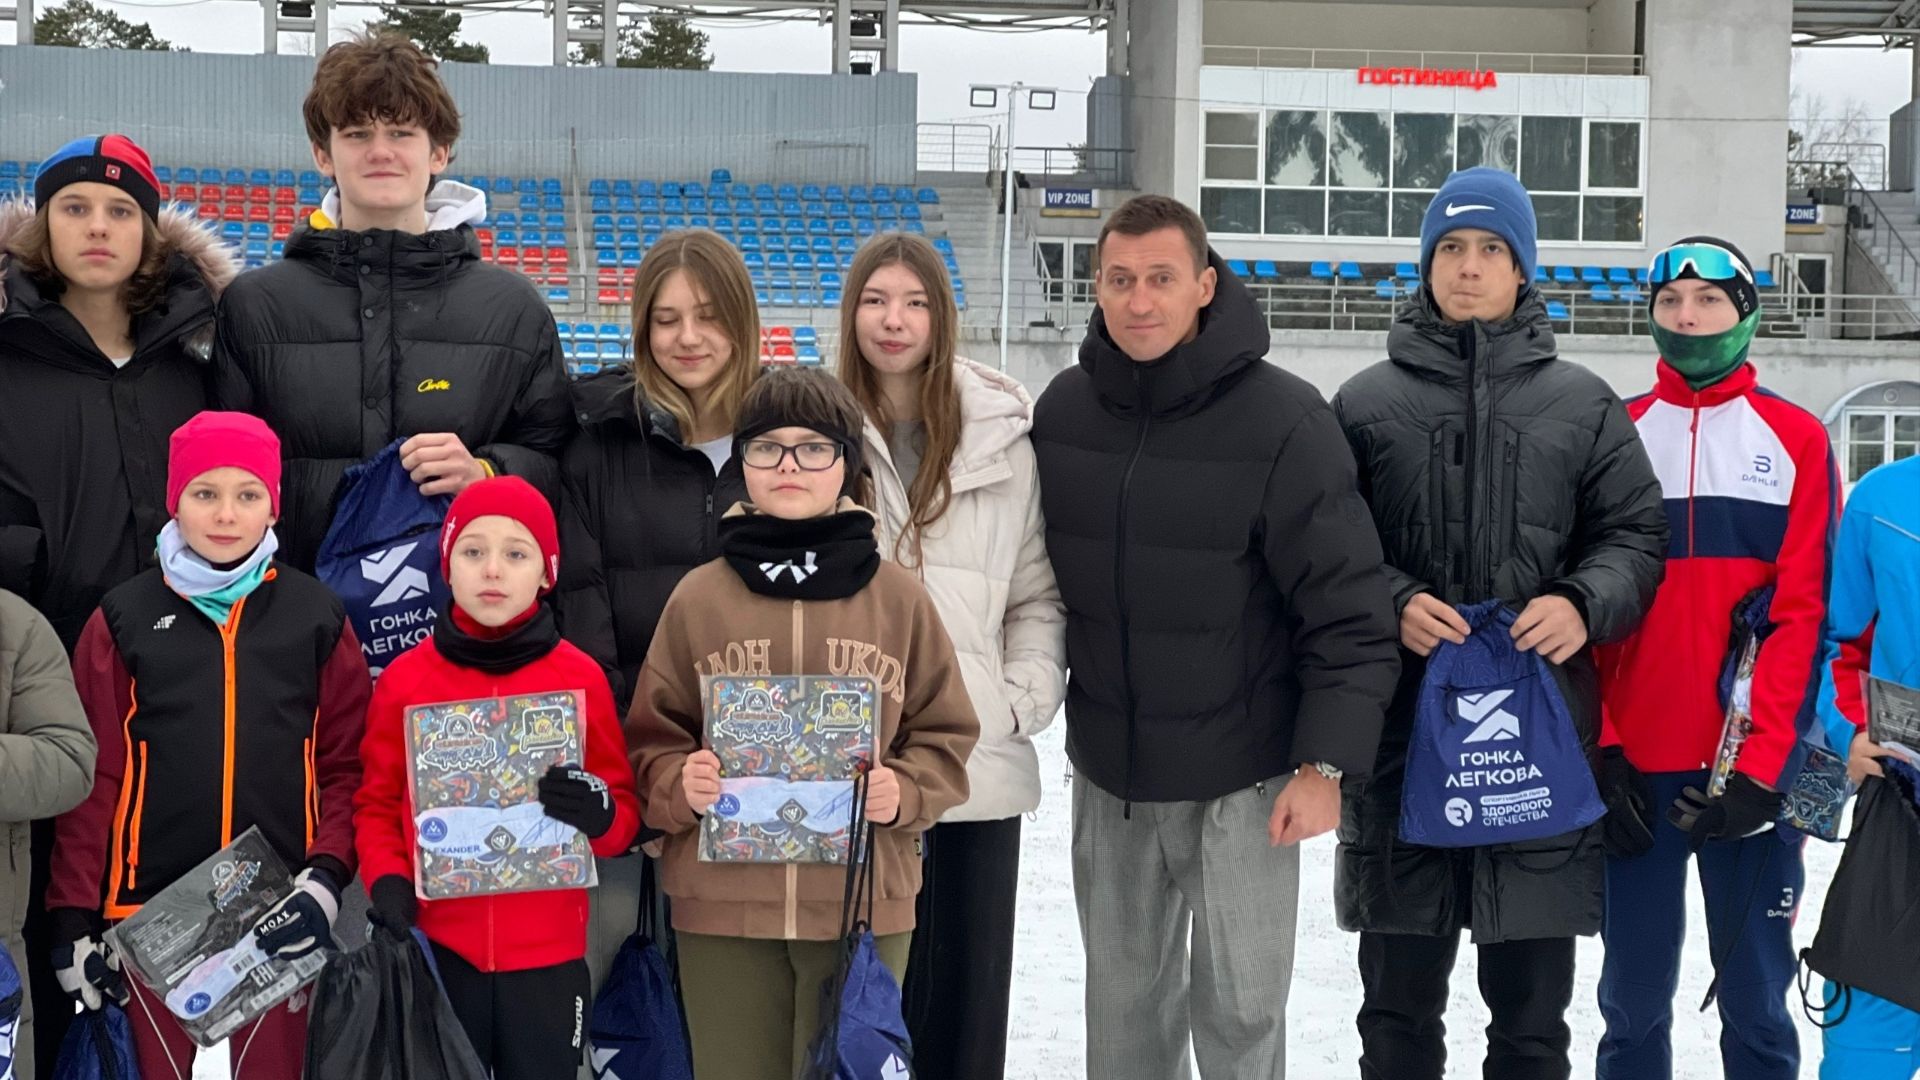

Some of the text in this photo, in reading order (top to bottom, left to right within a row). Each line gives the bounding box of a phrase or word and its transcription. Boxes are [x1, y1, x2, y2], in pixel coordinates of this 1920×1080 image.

[1358, 66, 1497, 91] ГОСТИНИЦА
[1047, 192, 1091, 204] VIP ZONE
[1790, 208, 1815, 220] ZONE
[369, 606, 438, 633] ГОНКА
[361, 625, 435, 656] ЛЕГКО
[1460, 750, 1524, 767] ГОНКА
[1445, 763, 1543, 788] ЛЕГКОВА
[1481, 798, 1552, 817] ЗДОРОВОГО
[1483, 809, 1549, 826] ОТЕЧЕСТВА
[260, 910, 290, 936] MOAX
